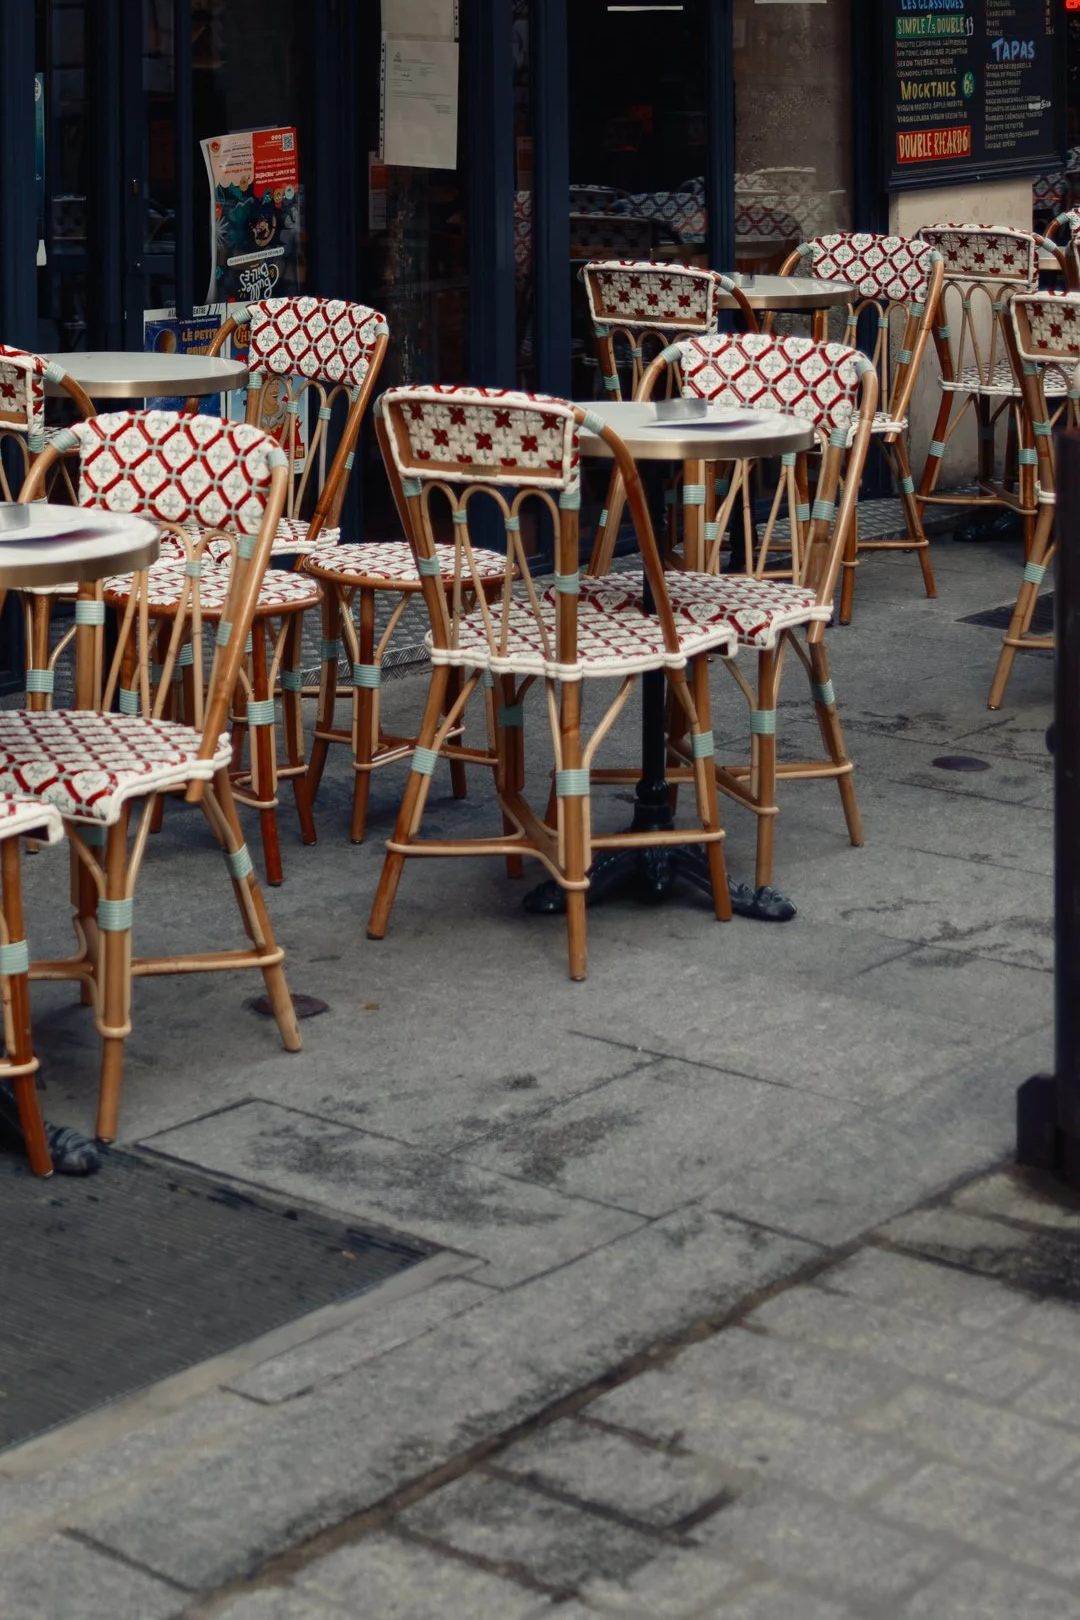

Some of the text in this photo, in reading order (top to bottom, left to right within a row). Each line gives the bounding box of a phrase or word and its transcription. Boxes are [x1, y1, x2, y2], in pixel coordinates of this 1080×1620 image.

[897, 17, 925, 35] SIMPLE
[936, 17, 964, 33] DOUBLE
[992, 37, 1035, 62] TAPAS
[901, 80, 956, 100] MOCKTAILS
[899, 129, 969, 158] DOUBLE RICARD 6
